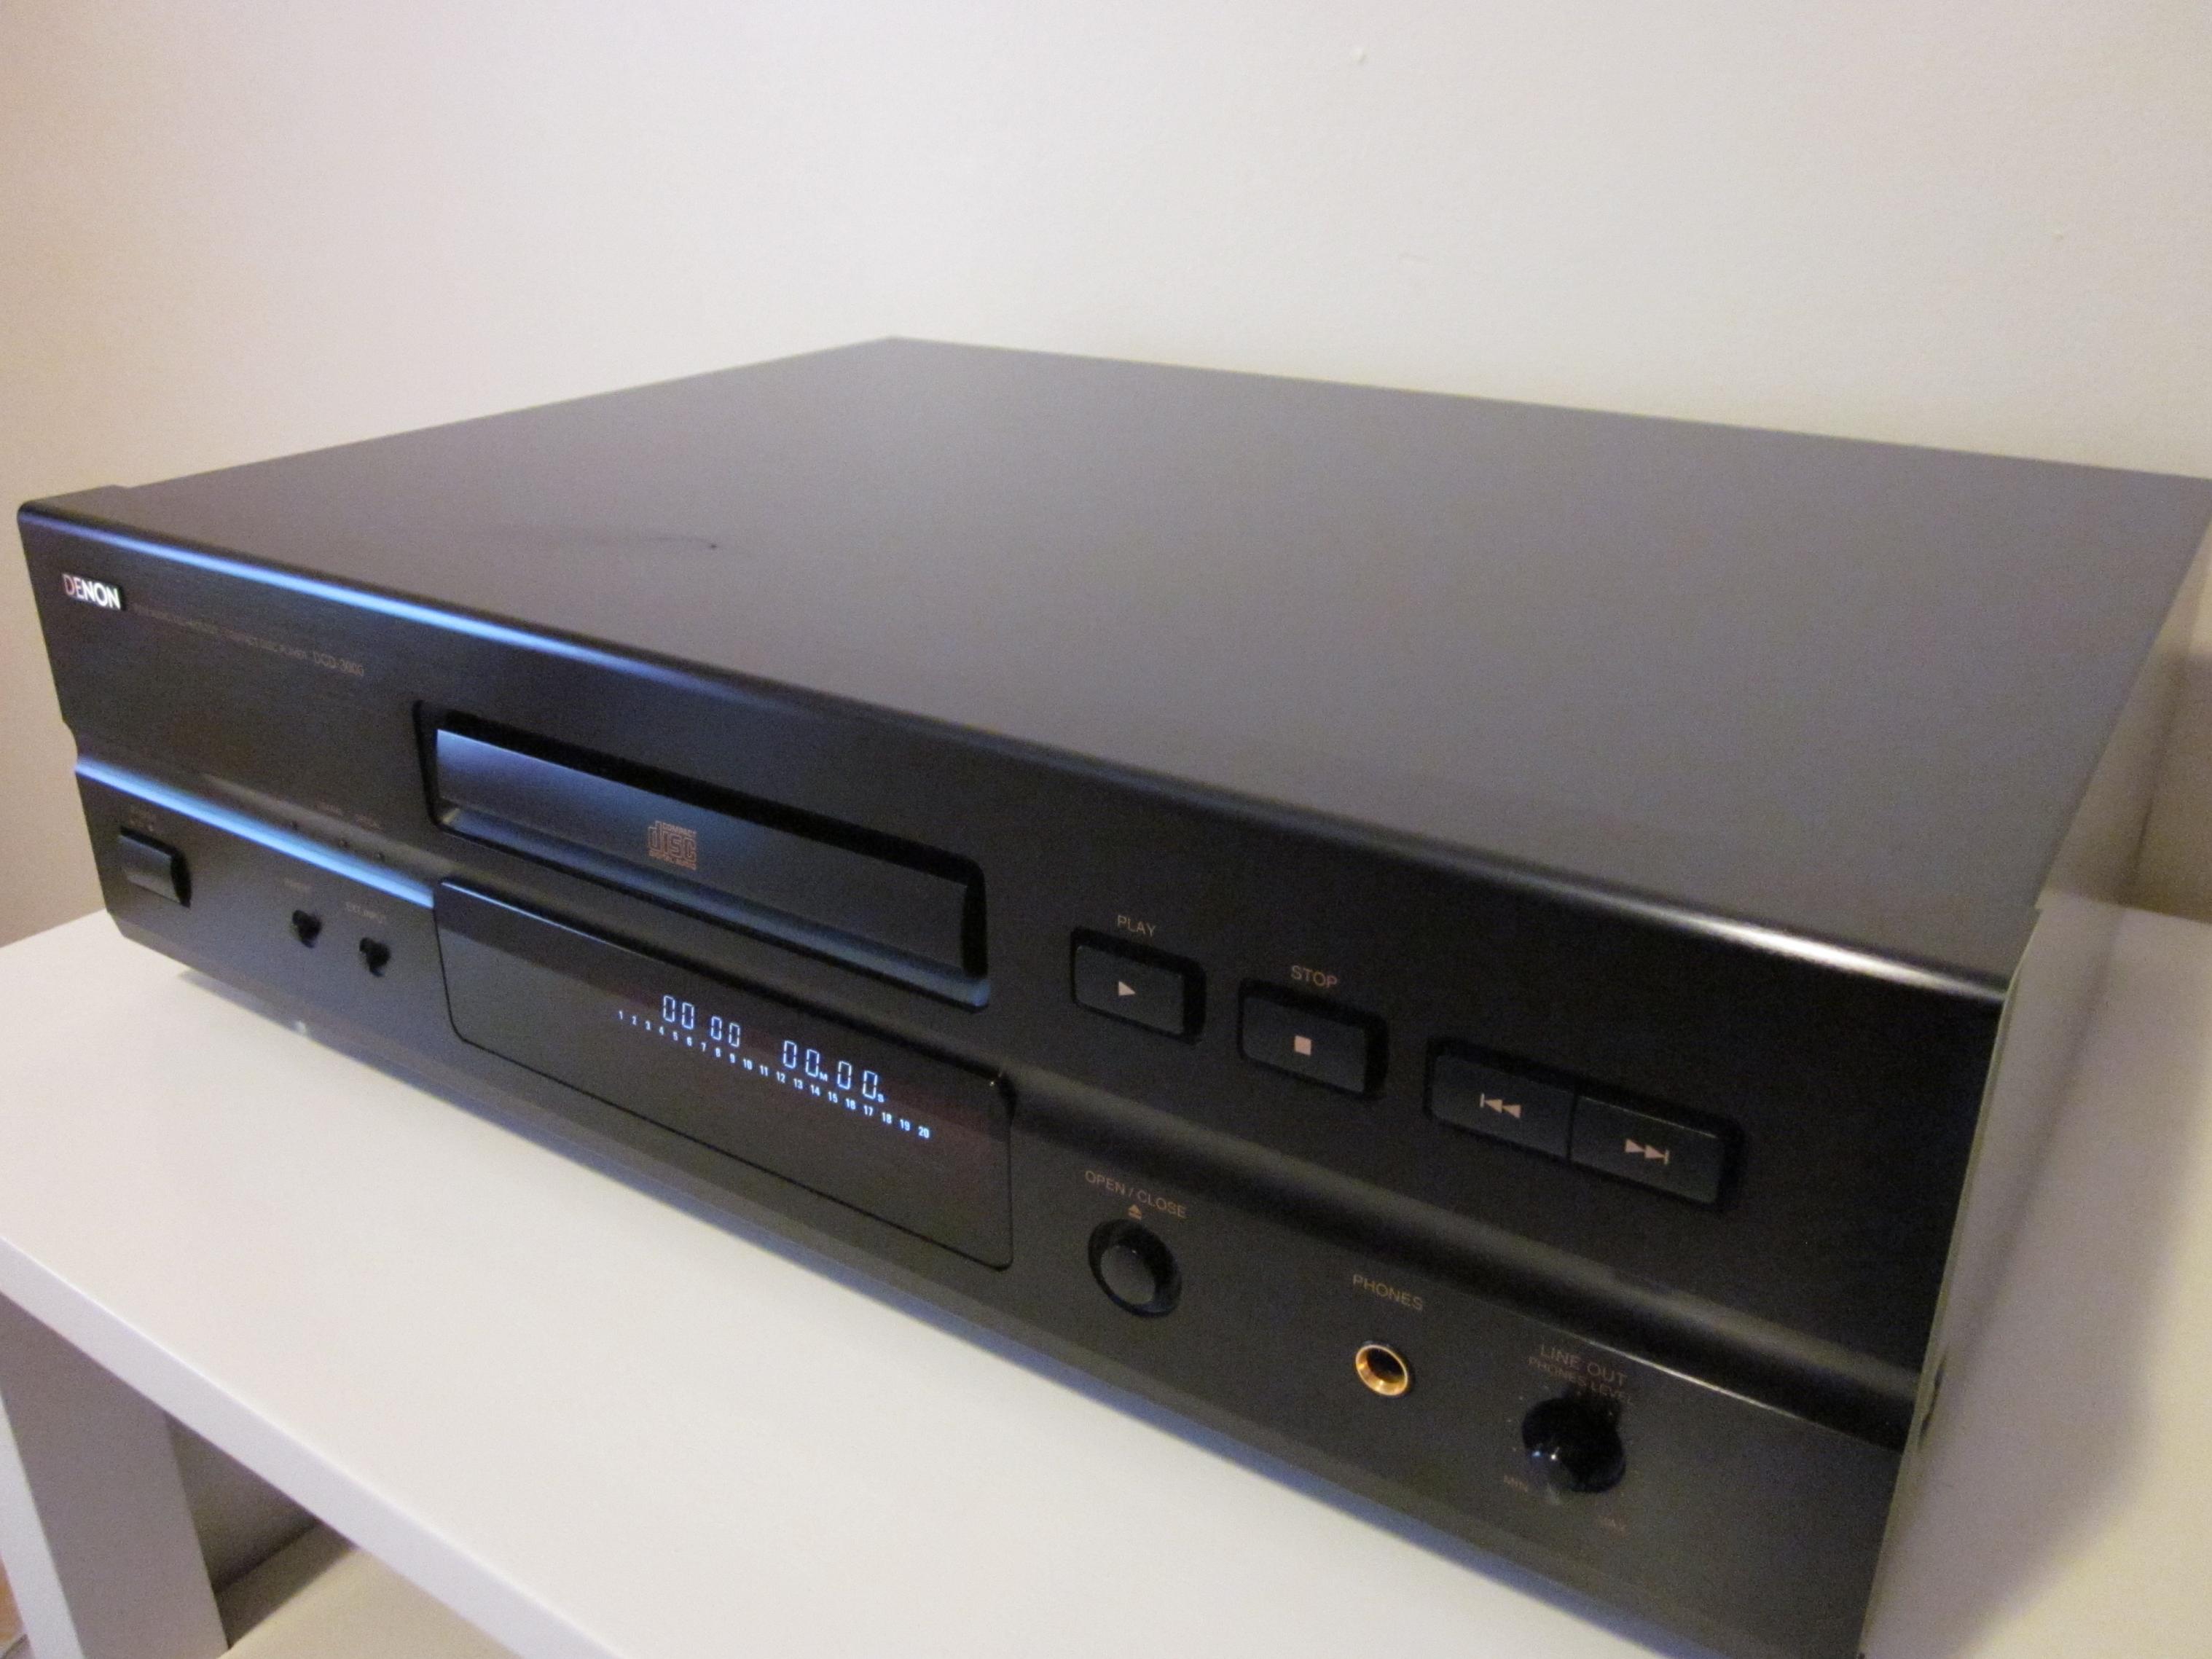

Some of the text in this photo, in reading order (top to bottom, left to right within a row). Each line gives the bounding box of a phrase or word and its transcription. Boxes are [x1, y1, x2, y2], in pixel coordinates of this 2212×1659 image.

[62, 573, 121, 609] DENON
[1118, 915, 1156, 937] PLAY
[1291, 965, 1338, 989] STOP
[663, 995, 694, 1030] 00
[710, 1016, 741, 1048] 00
[618, 1010, 931, 1140] 1 2 3 4 5 6 7 8 9 10 11 12 13 14 15 16 17 18 19 20
[1352, 1274, 1424, 1311] PHONES
[1528, 1356, 1586, 1388] PHONES
[1540, 1344, 1628, 1388] LINE OUT
